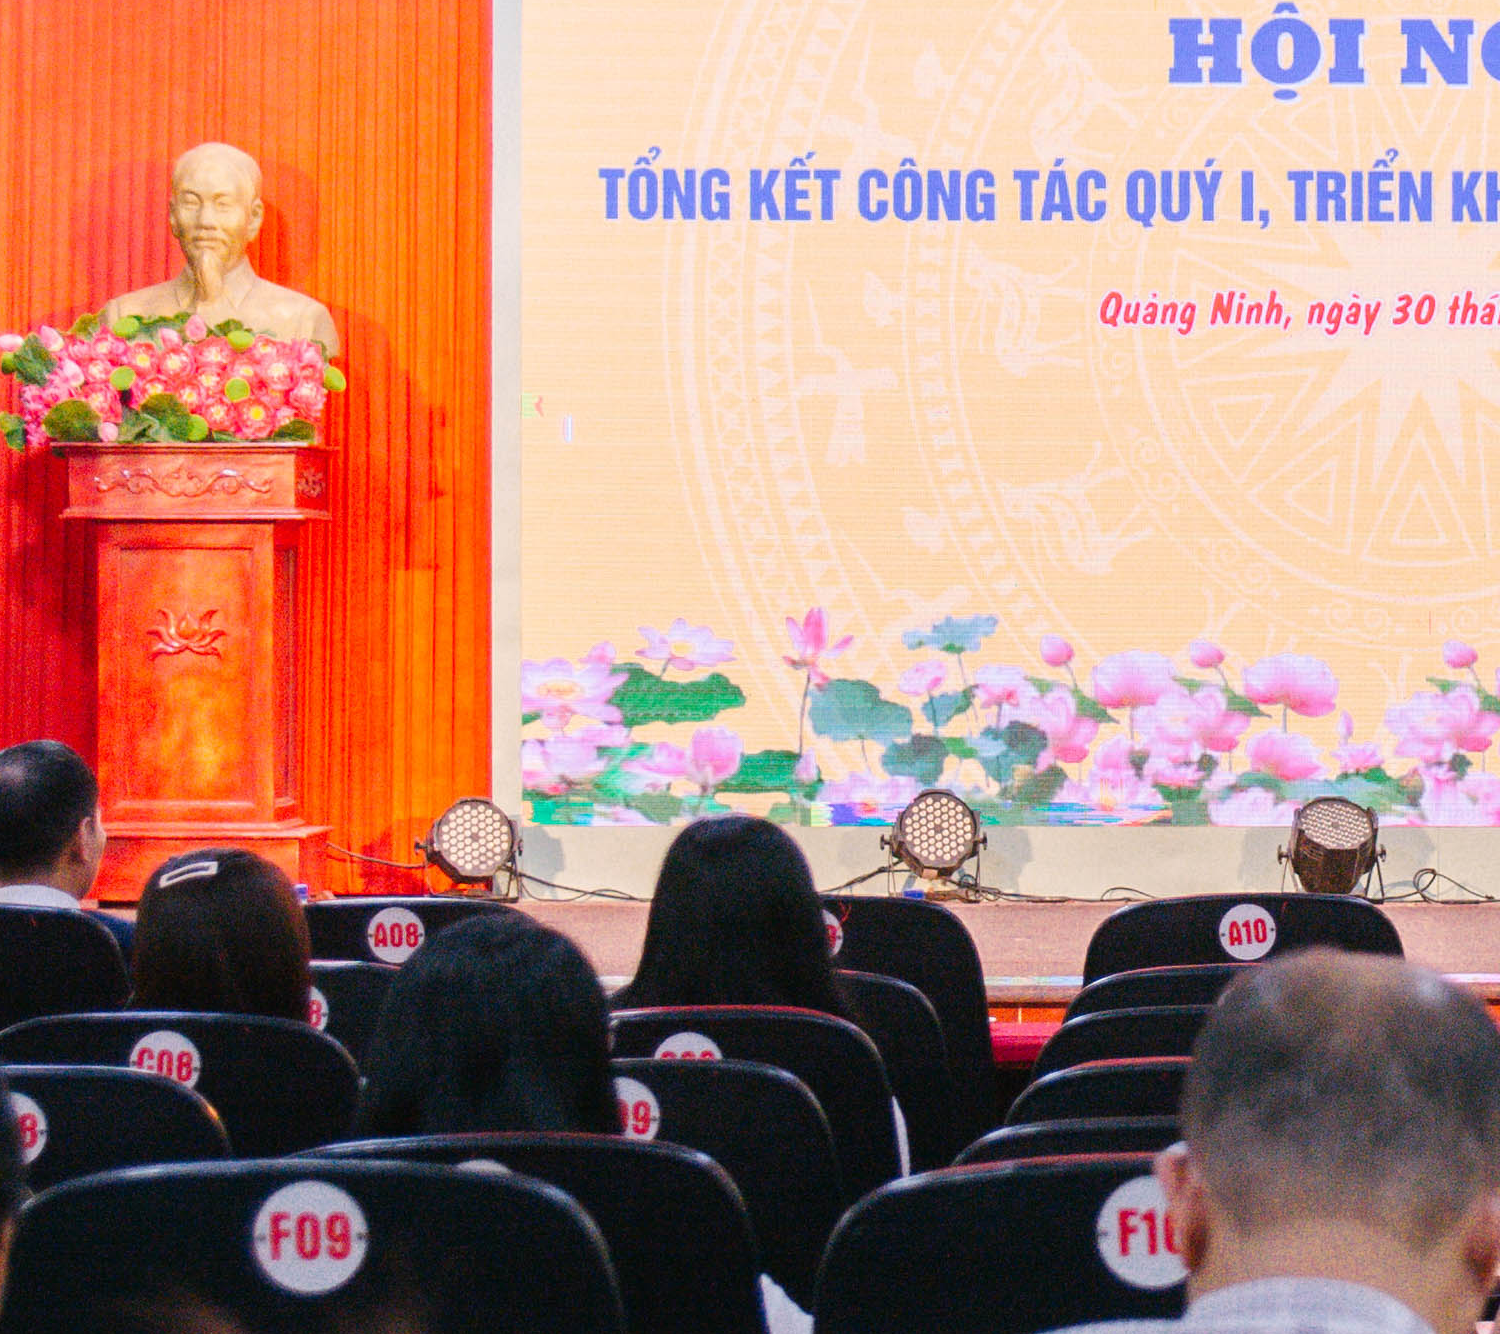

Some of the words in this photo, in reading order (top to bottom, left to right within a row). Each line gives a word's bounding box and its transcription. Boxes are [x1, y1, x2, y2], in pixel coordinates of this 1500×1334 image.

[1169, 2, 1367, 102] HỘI
[599, 147, 730, 221] TỔNG
[749, 151, 841, 221] KẾT
[858, 157, 996, 222] CÔNG
[1013, 158, 1107, 223] TÁC
[1126, 159, 1222, 228] QUÝ
[1287, 148, 1433, 223] TRIỂN
[1100, 292, 1196, 335] Quảng
[1211, 291, 1291, 329] Ninh,
[1308, 295, 1381, 335] ngày
[1393, 295, 1435, 325] 30
[373, 922, 419, 949] A08
[1228, 917, 1268, 947] A10
[269, 1212, 351, 1260] F09
